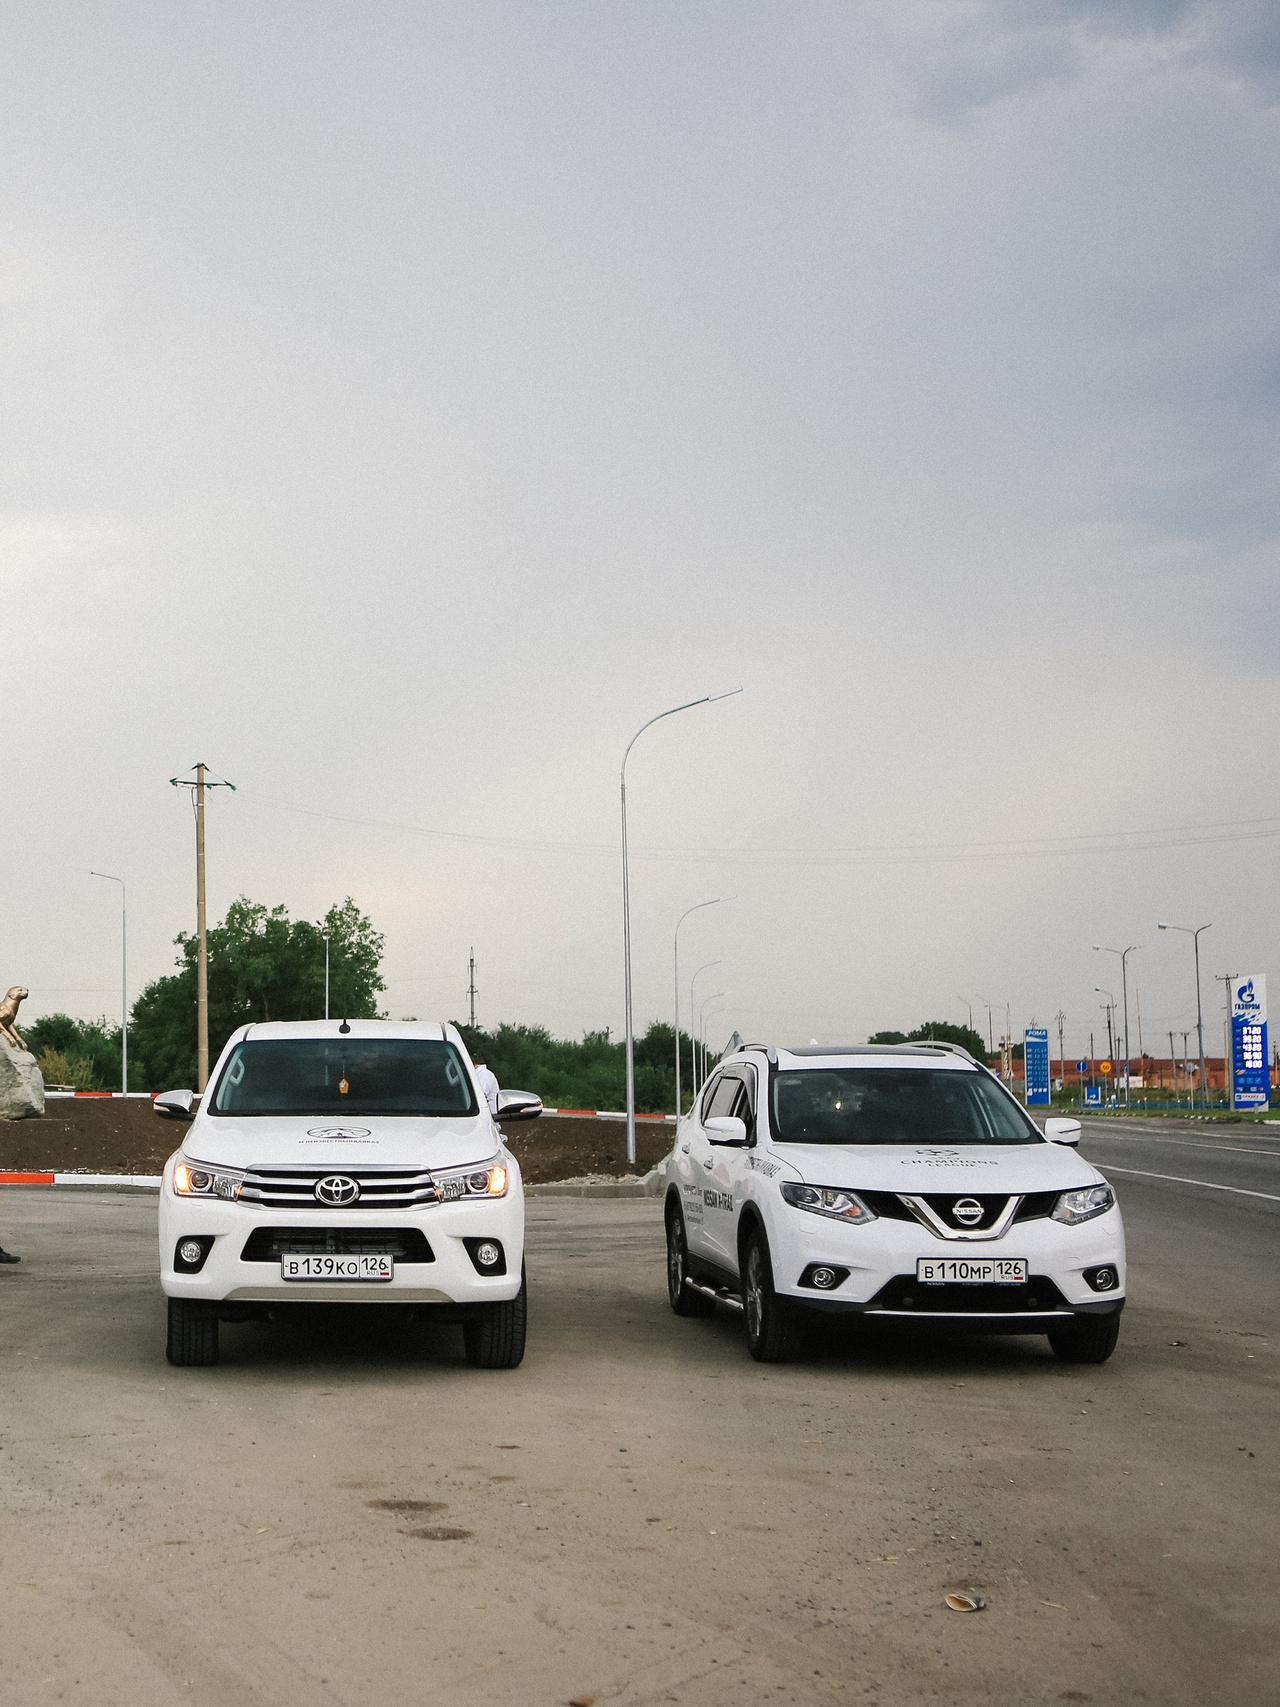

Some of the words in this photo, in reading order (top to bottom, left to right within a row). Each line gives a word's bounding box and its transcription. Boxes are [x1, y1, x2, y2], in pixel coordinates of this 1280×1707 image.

[289, 1258, 358, 1275] В139КО
[361, 1257, 388, 1270] 126
[924, 1262, 992, 1279] В110МР
[996, 1262, 1022, 1275] 126
